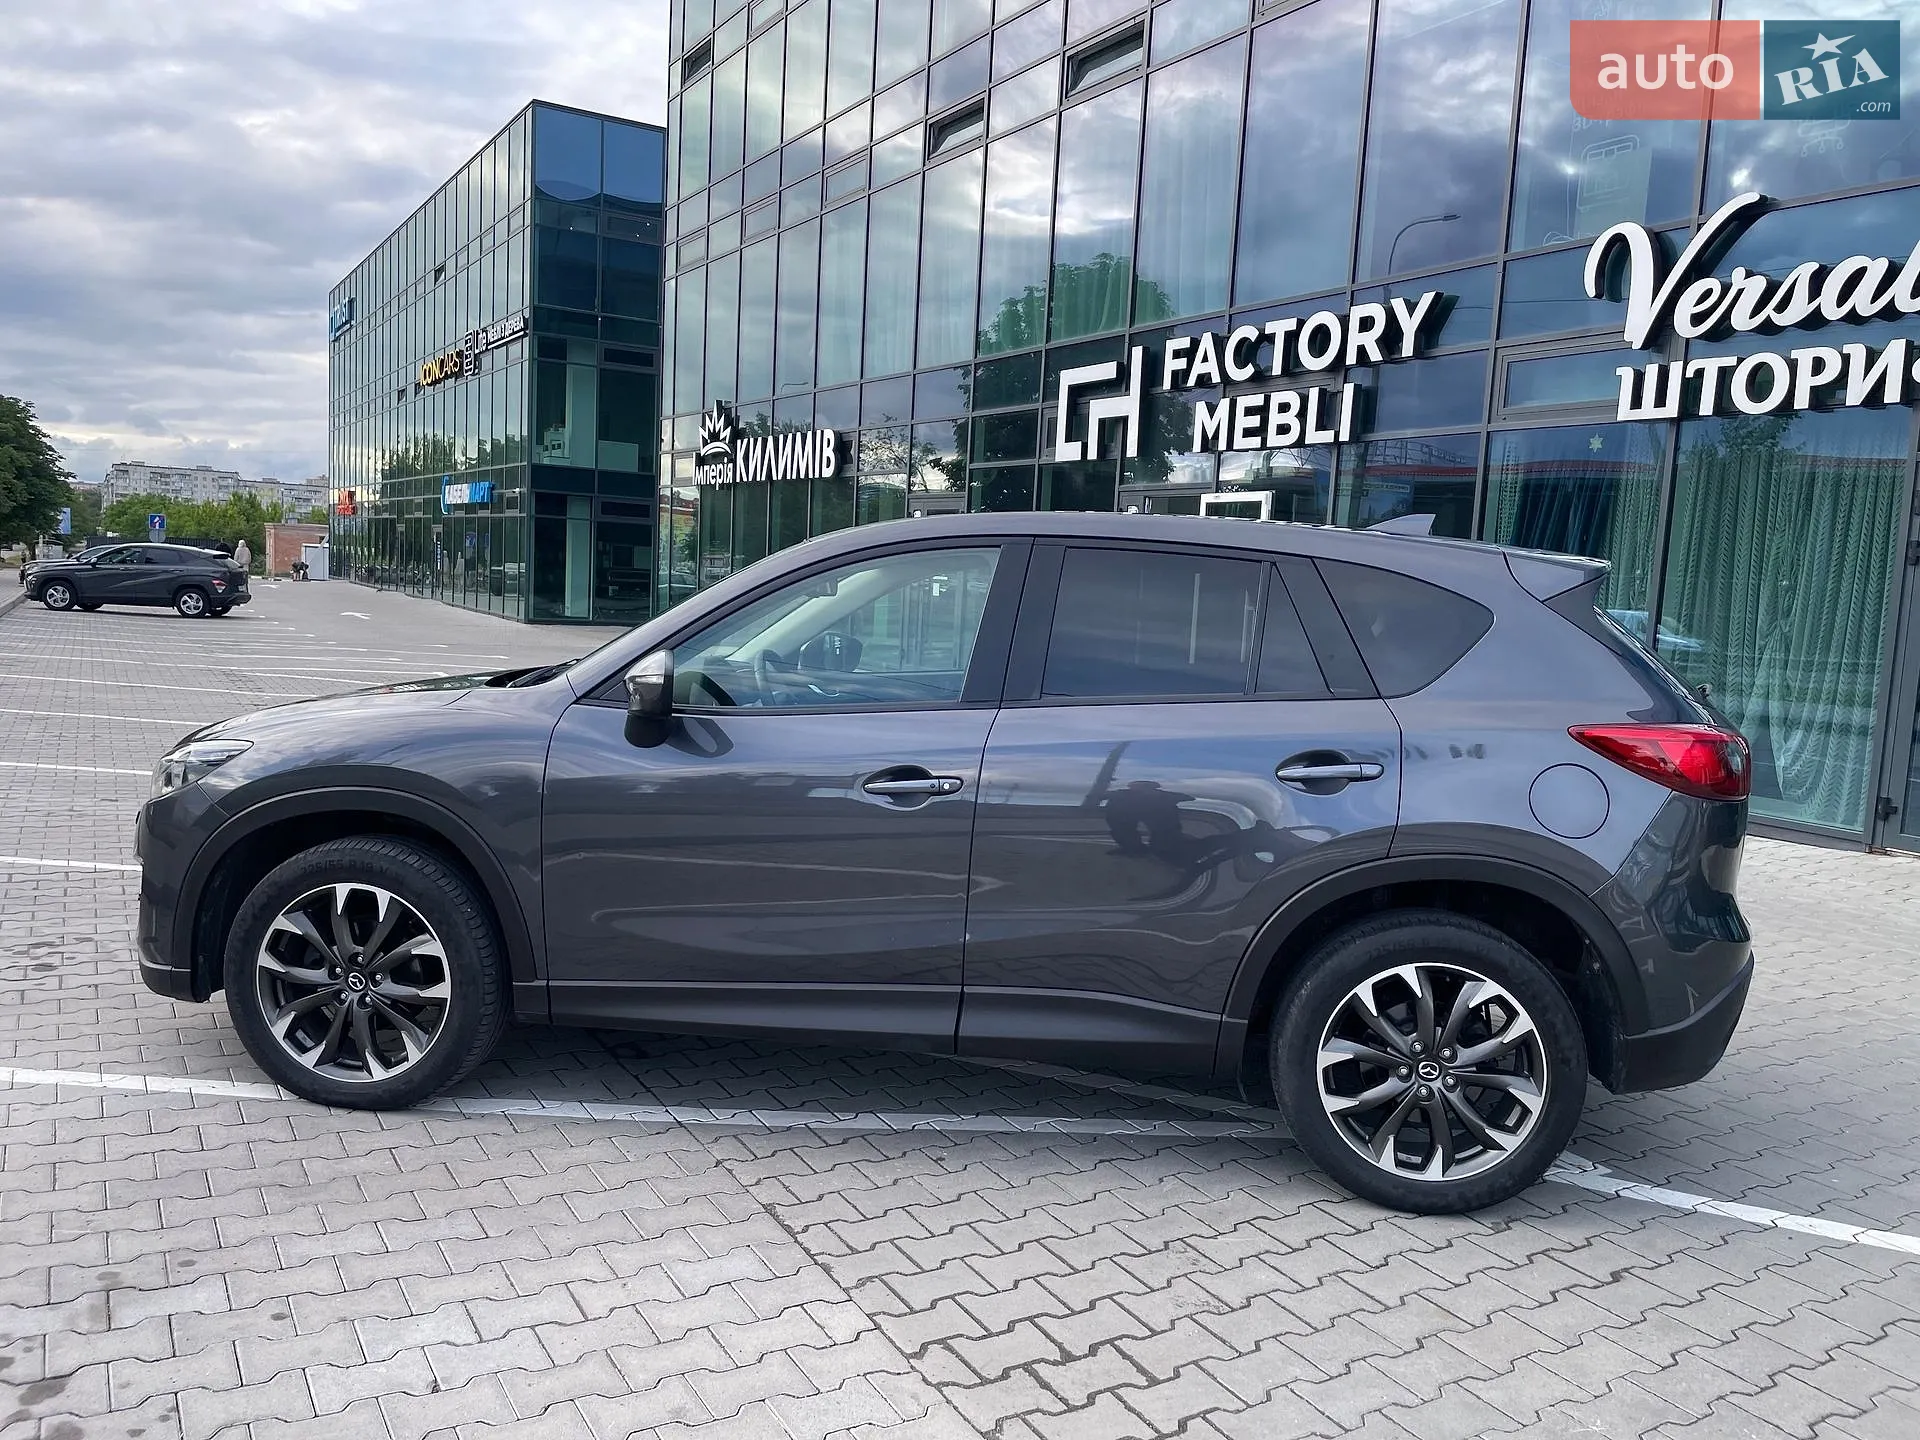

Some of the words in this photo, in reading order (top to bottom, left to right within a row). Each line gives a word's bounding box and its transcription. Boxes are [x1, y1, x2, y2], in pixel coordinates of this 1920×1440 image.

[1162, 291, 1440, 390] FACTORY
[1192, 382, 1354, 453] MEBLI
[1615, 338, 1920, 421] ШТОРИ
[692, 451, 734, 490] Імперія
[736, 429, 836, 482] КИЛИМІВ
